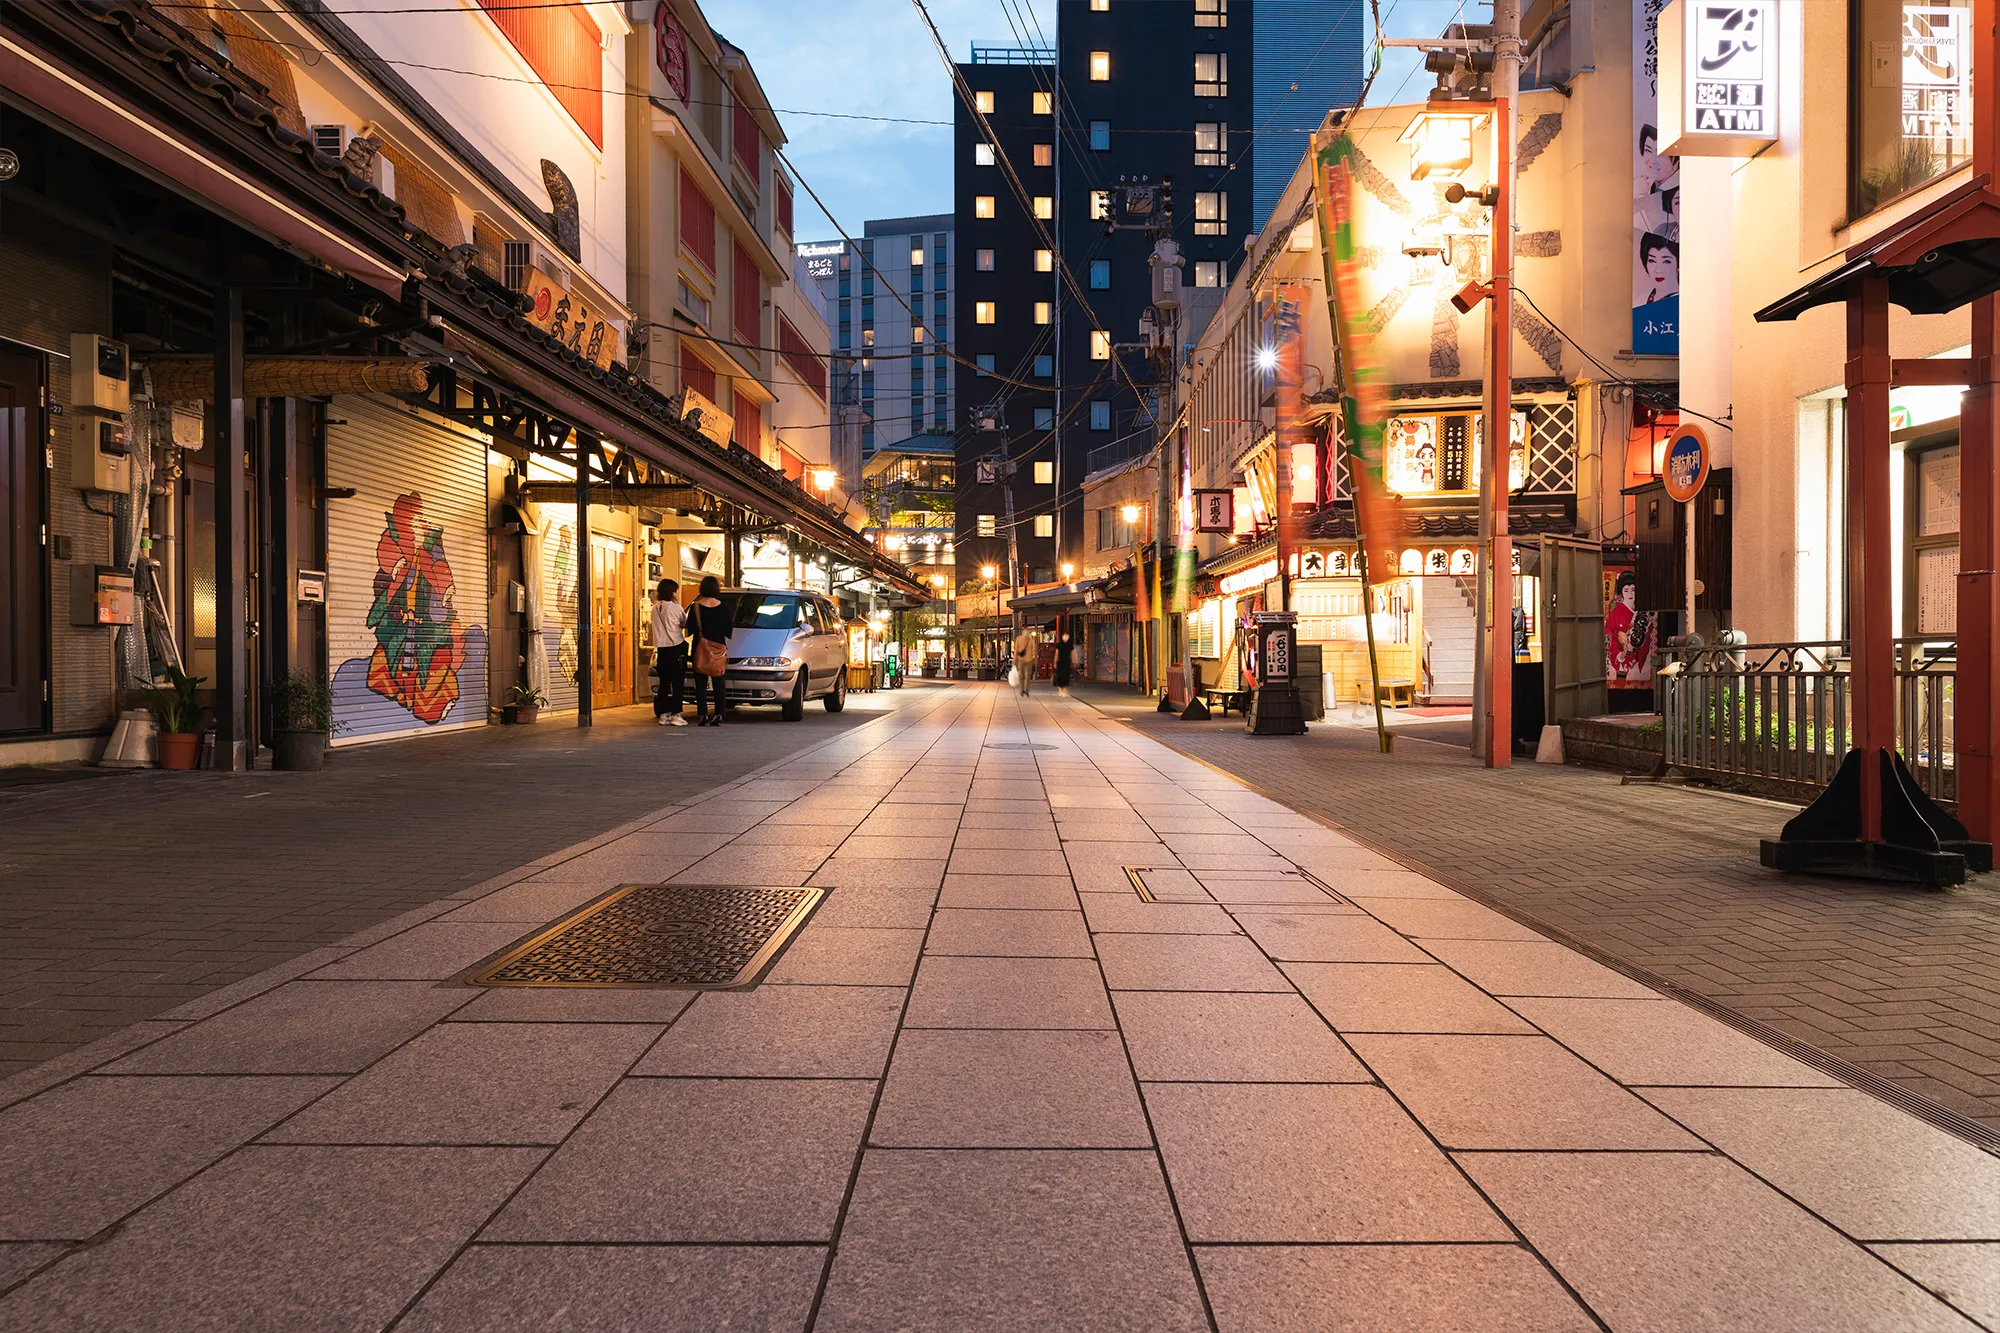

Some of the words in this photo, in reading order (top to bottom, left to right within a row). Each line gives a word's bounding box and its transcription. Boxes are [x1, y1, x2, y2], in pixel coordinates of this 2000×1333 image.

[1700, 109, 1760, 130] ATM
[797, 241, 844, 257] Richmond
[808, 259, 833, 269] まるごと
[1643, 320, 1679, 337] 小江
[1671, 449, 1701, 476] 消防水利
